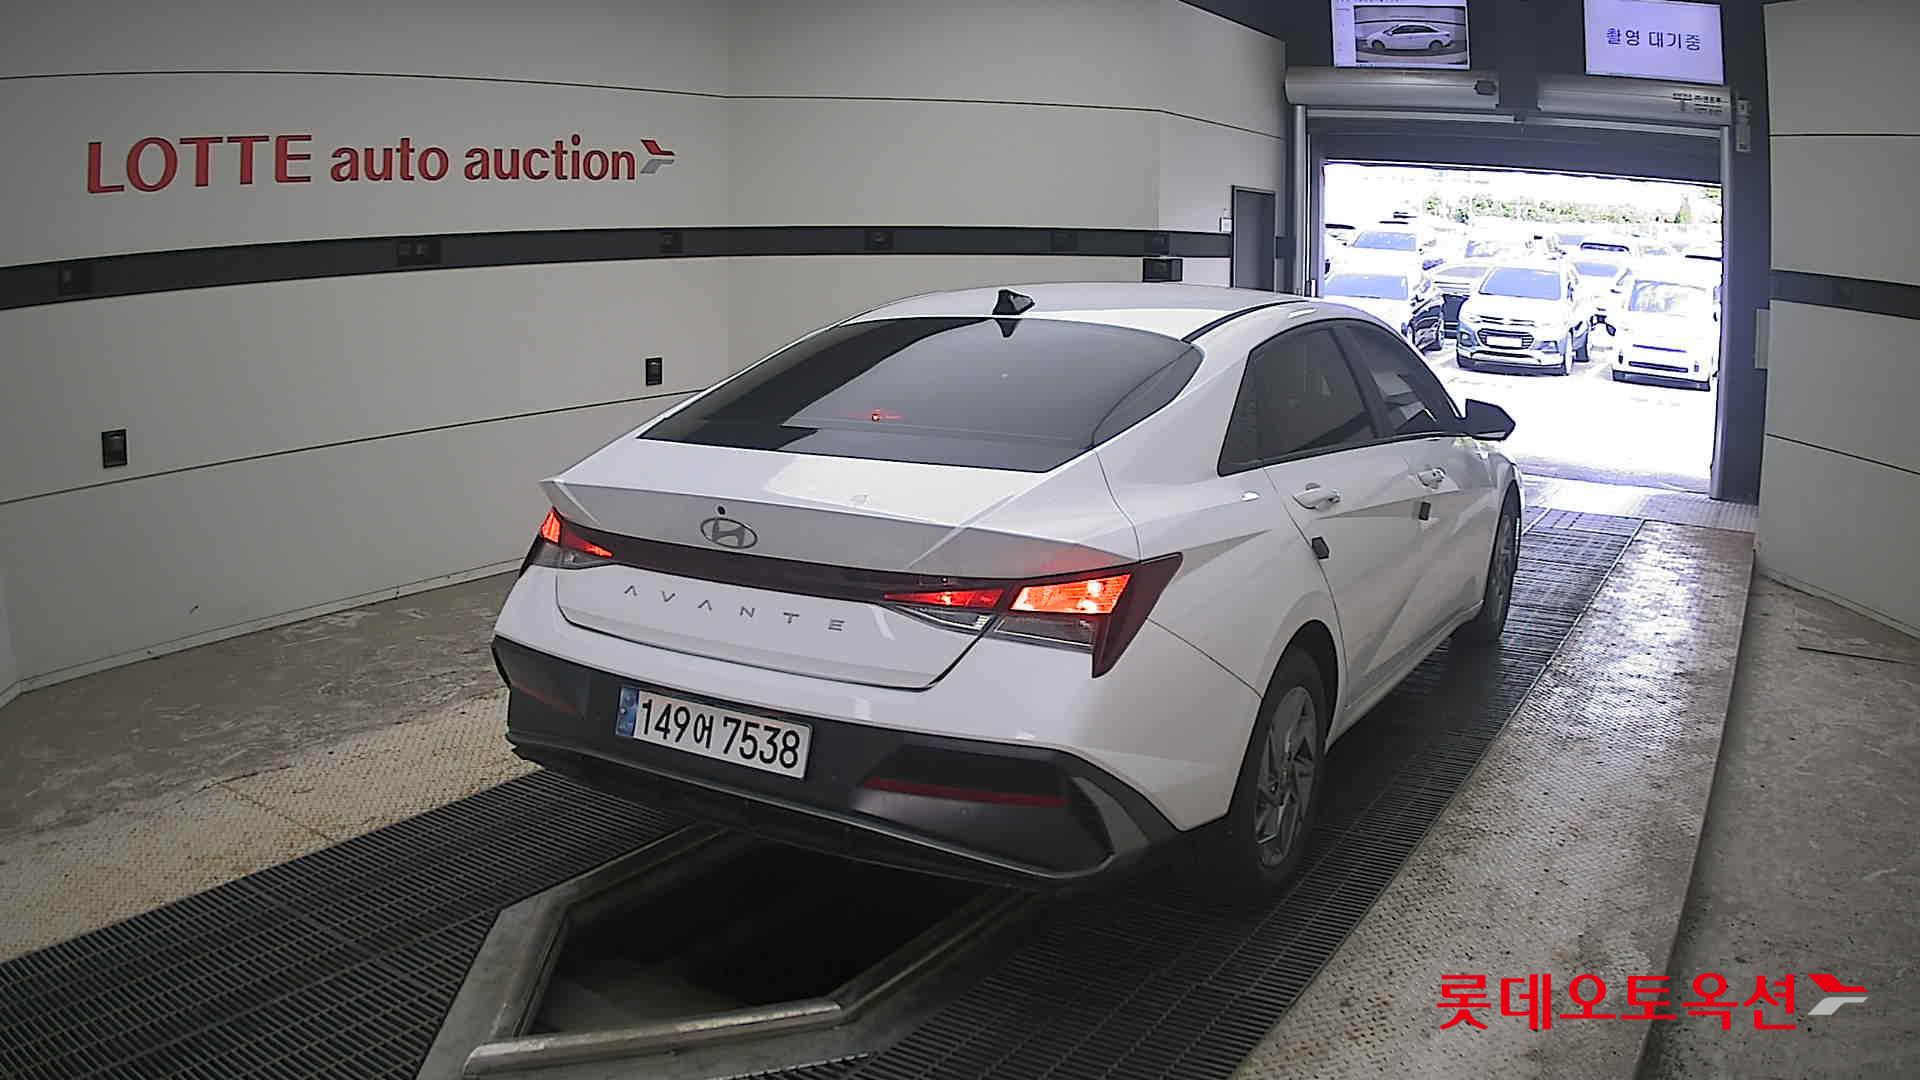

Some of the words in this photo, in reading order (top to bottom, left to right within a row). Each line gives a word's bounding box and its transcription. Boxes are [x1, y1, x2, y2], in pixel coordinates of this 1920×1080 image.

[1606, 27, 1640, 47] 촬영
[1648, 31, 1701, 51] 대기중
[87, 134, 313, 194] LOTTE
[330, 137, 450, 182] auto
[463, 134, 637, 181] auction
[623, 584, 845, 632] AVANTE
[641, 698, 714, 749] 149어
[722, 716, 800, 769] 7538
